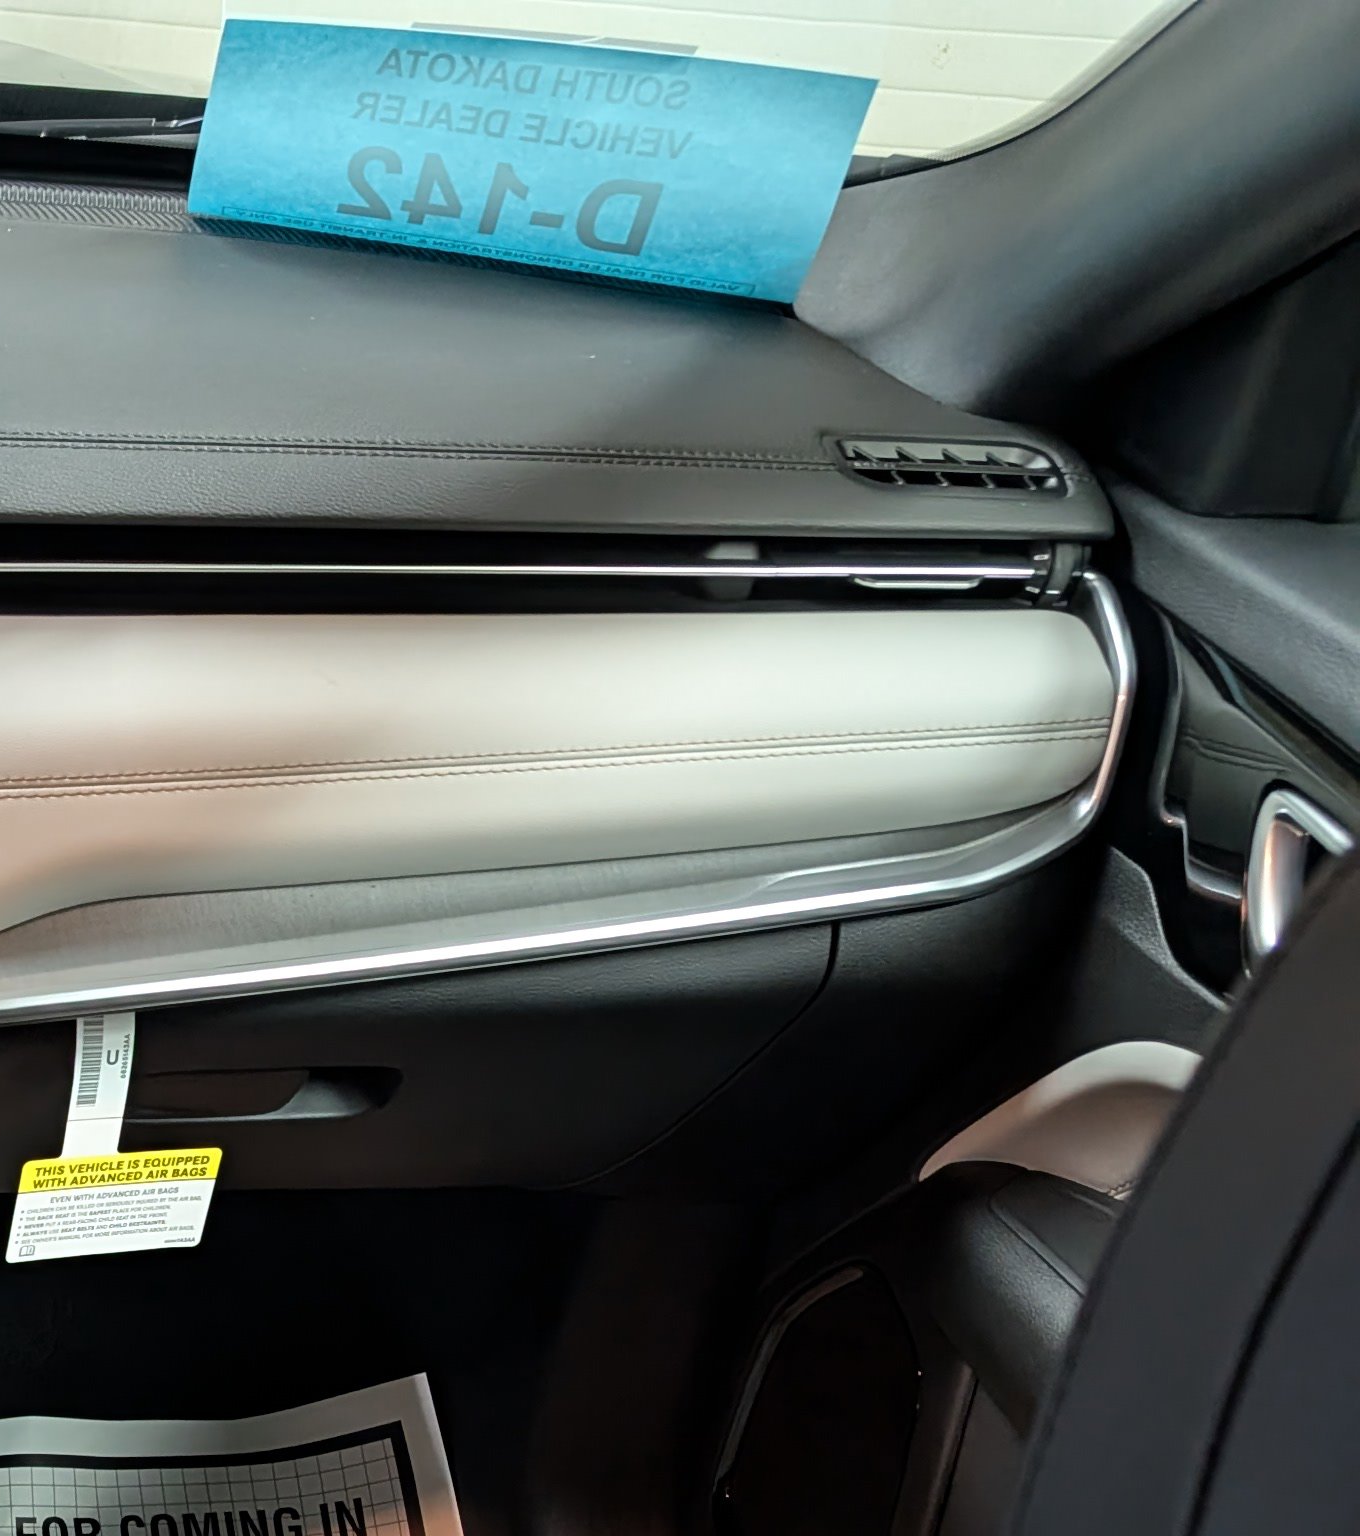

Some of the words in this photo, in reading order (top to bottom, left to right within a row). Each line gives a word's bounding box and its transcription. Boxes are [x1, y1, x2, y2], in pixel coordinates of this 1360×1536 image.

[106, 1049, 119, 1065] U
[36, 1166, 65, 1177] THIS
[69, 1160, 125, 1174] VEHICLE
[127, 1159, 140, 1169] IS
[143, 1155, 210, 1168] EQUIPPED
[33, 1177, 67, 1189] WITH
[70, 1171, 142, 1186] ADVANCED
[146, 1169, 168, 1179] AIR
[172, 1167, 208, 1178] BAGS
[74, 1193, 94, 1202] WITH
[96, 1189, 140, 1199] ADVANCED
[158, 1187, 179, 1195] BAGS
